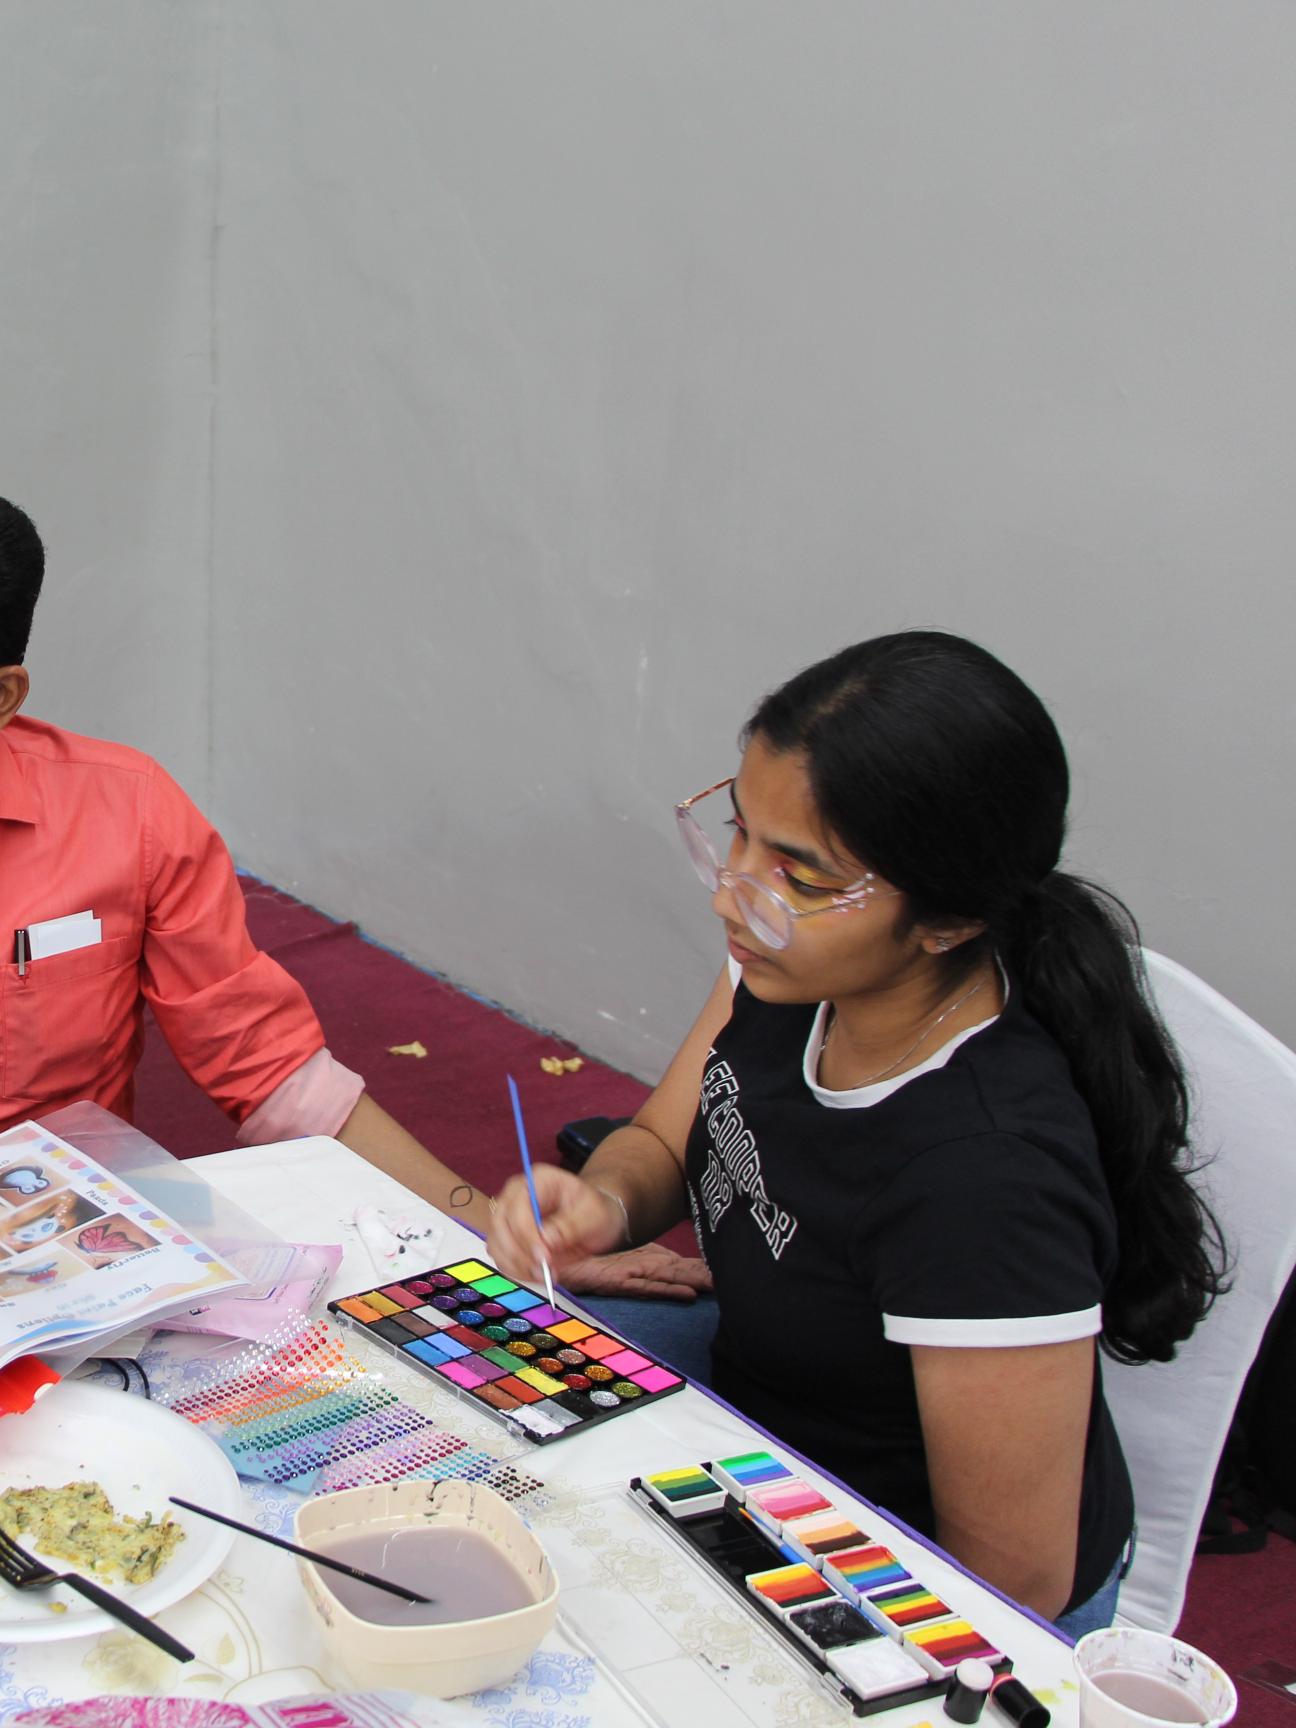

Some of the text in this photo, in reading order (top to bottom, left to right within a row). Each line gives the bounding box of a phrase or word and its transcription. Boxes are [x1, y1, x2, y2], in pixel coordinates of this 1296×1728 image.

[86, 1189, 109, 1206] Panda
[106, 1247, 161, 1271] Butterfly
[117, 1282, 153, 1301] Face
[16, 1313, 76, 1330] Options
